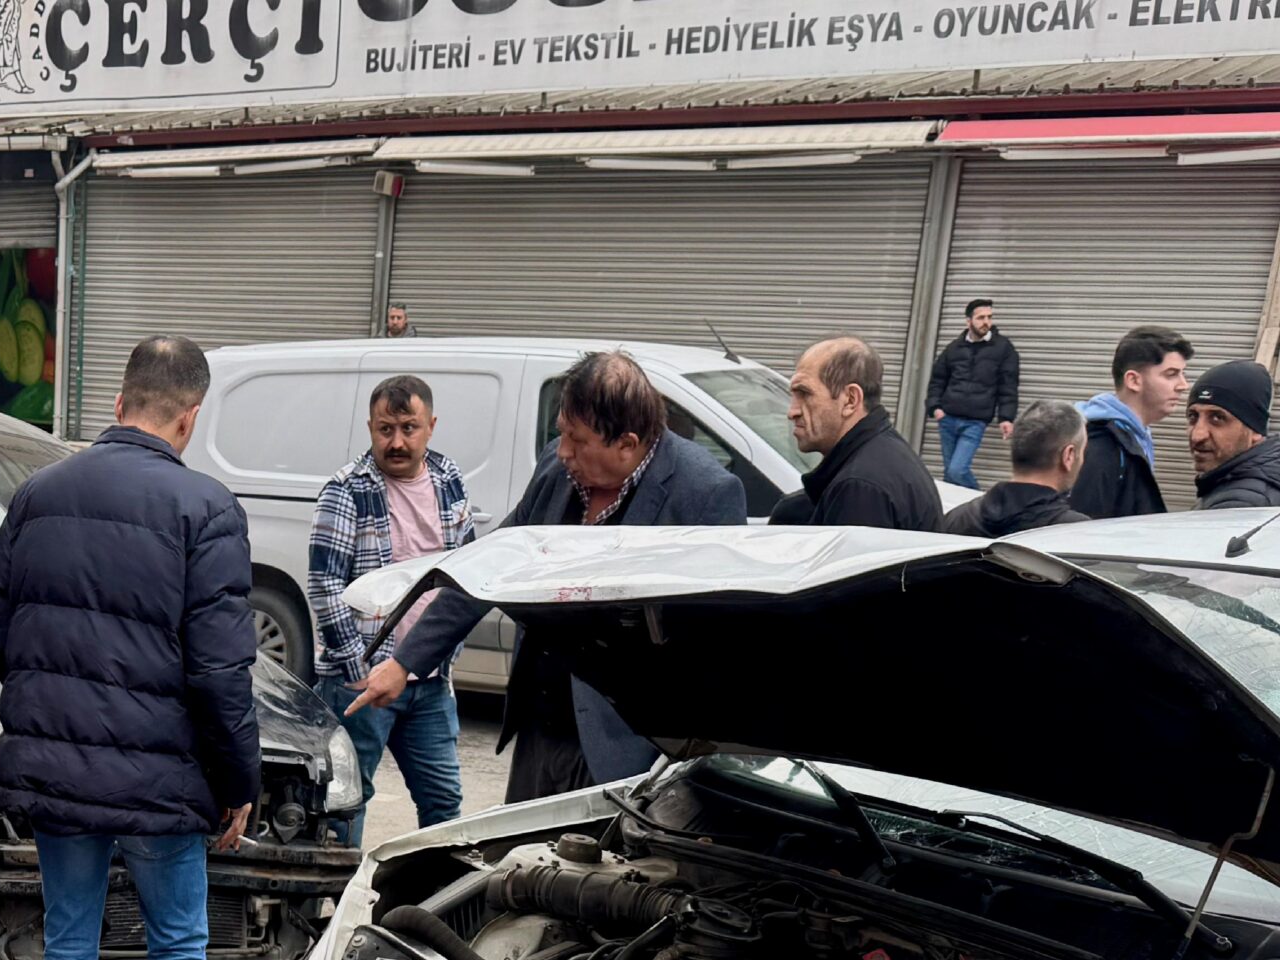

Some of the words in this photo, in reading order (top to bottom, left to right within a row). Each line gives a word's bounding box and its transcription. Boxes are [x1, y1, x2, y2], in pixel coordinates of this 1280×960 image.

[365, 36, 472, 74] BUJİTERİ
[493, 38, 527, 67] EV
[533, 25, 641, 64] TEKSTİL
[665, 12, 820, 56] HEDİYELİK
[826, 11, 904, 52] EŞYA
[933, 0, 1097, 39] OYUNCAK
